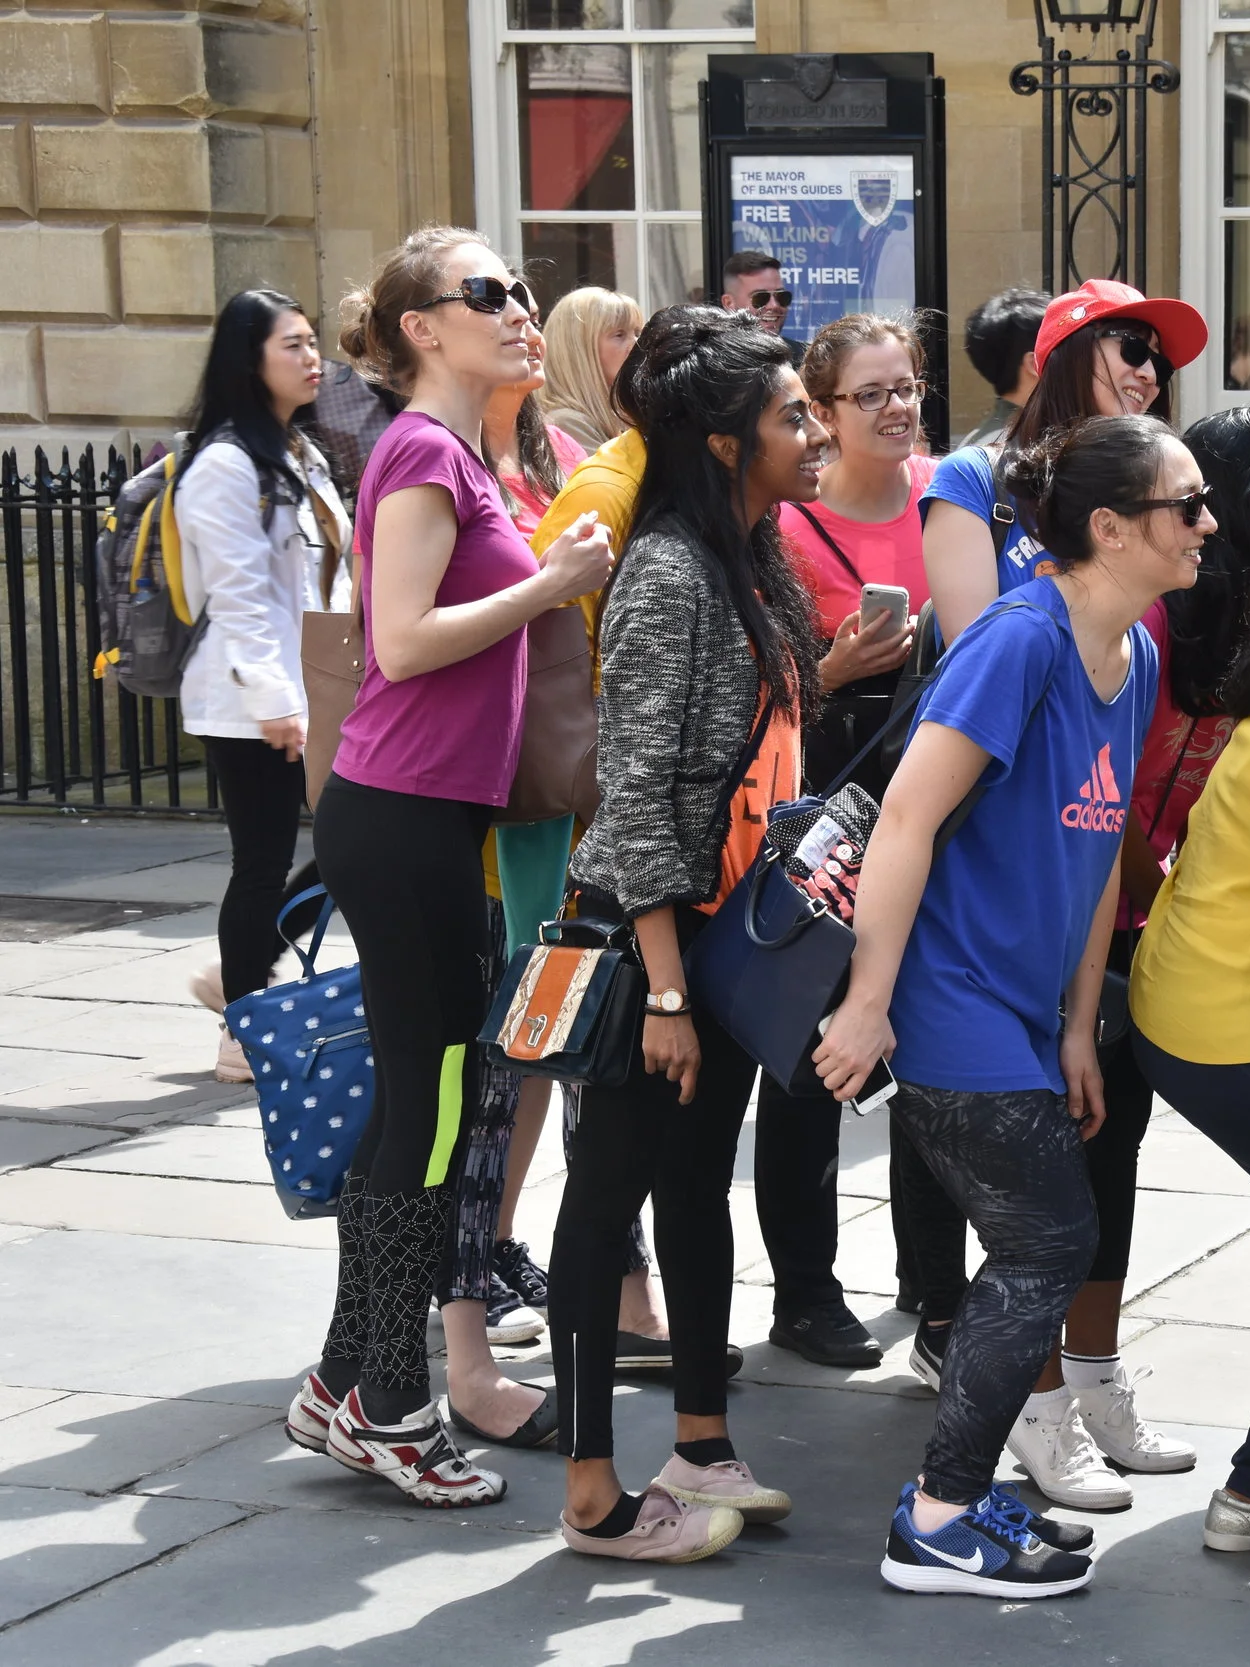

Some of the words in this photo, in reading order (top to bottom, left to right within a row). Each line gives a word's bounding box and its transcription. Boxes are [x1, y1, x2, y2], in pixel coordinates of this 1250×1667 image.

[741, 171, 764, 181] THE
[766, 171, 805, 181] MAYOR
[741, 185, 756, 195] OF
[759, 185, 798, 195] BATH'S
[800, 185, 843, 195] GUIDES
[741, 205, 791, 222] FREE
[742, 226, 830, 243] WALKING
[808, 268, 860, 284] HERE
[1060, 797, 1127, 834] adidas
